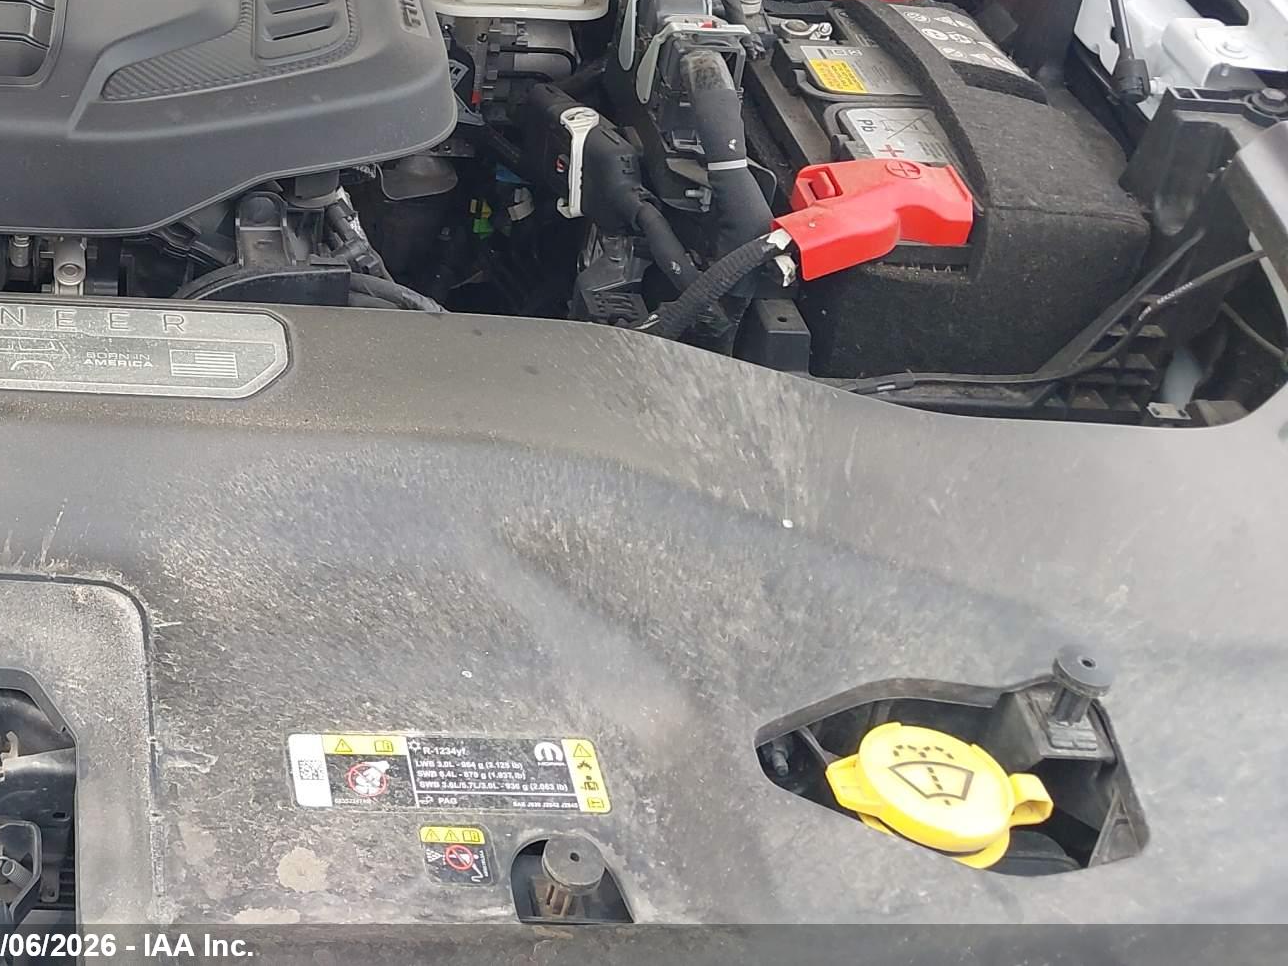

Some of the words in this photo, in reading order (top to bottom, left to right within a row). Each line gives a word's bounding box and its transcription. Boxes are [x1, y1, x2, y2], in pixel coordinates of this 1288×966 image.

[856, 119, 878, 133] Pb
[86, 351, 130, 360] BORN
[132, 353, 150, 361] IN
[82, 358, 153, 368] AMERICA
[422, 746, 466, 757] R-1234yf
[415, 760, 436, 768] LWB
[416, 770, 438, 778] SWB
[419, 781, 440, 789] SWB
[437, 796, 458, 805] PAG
